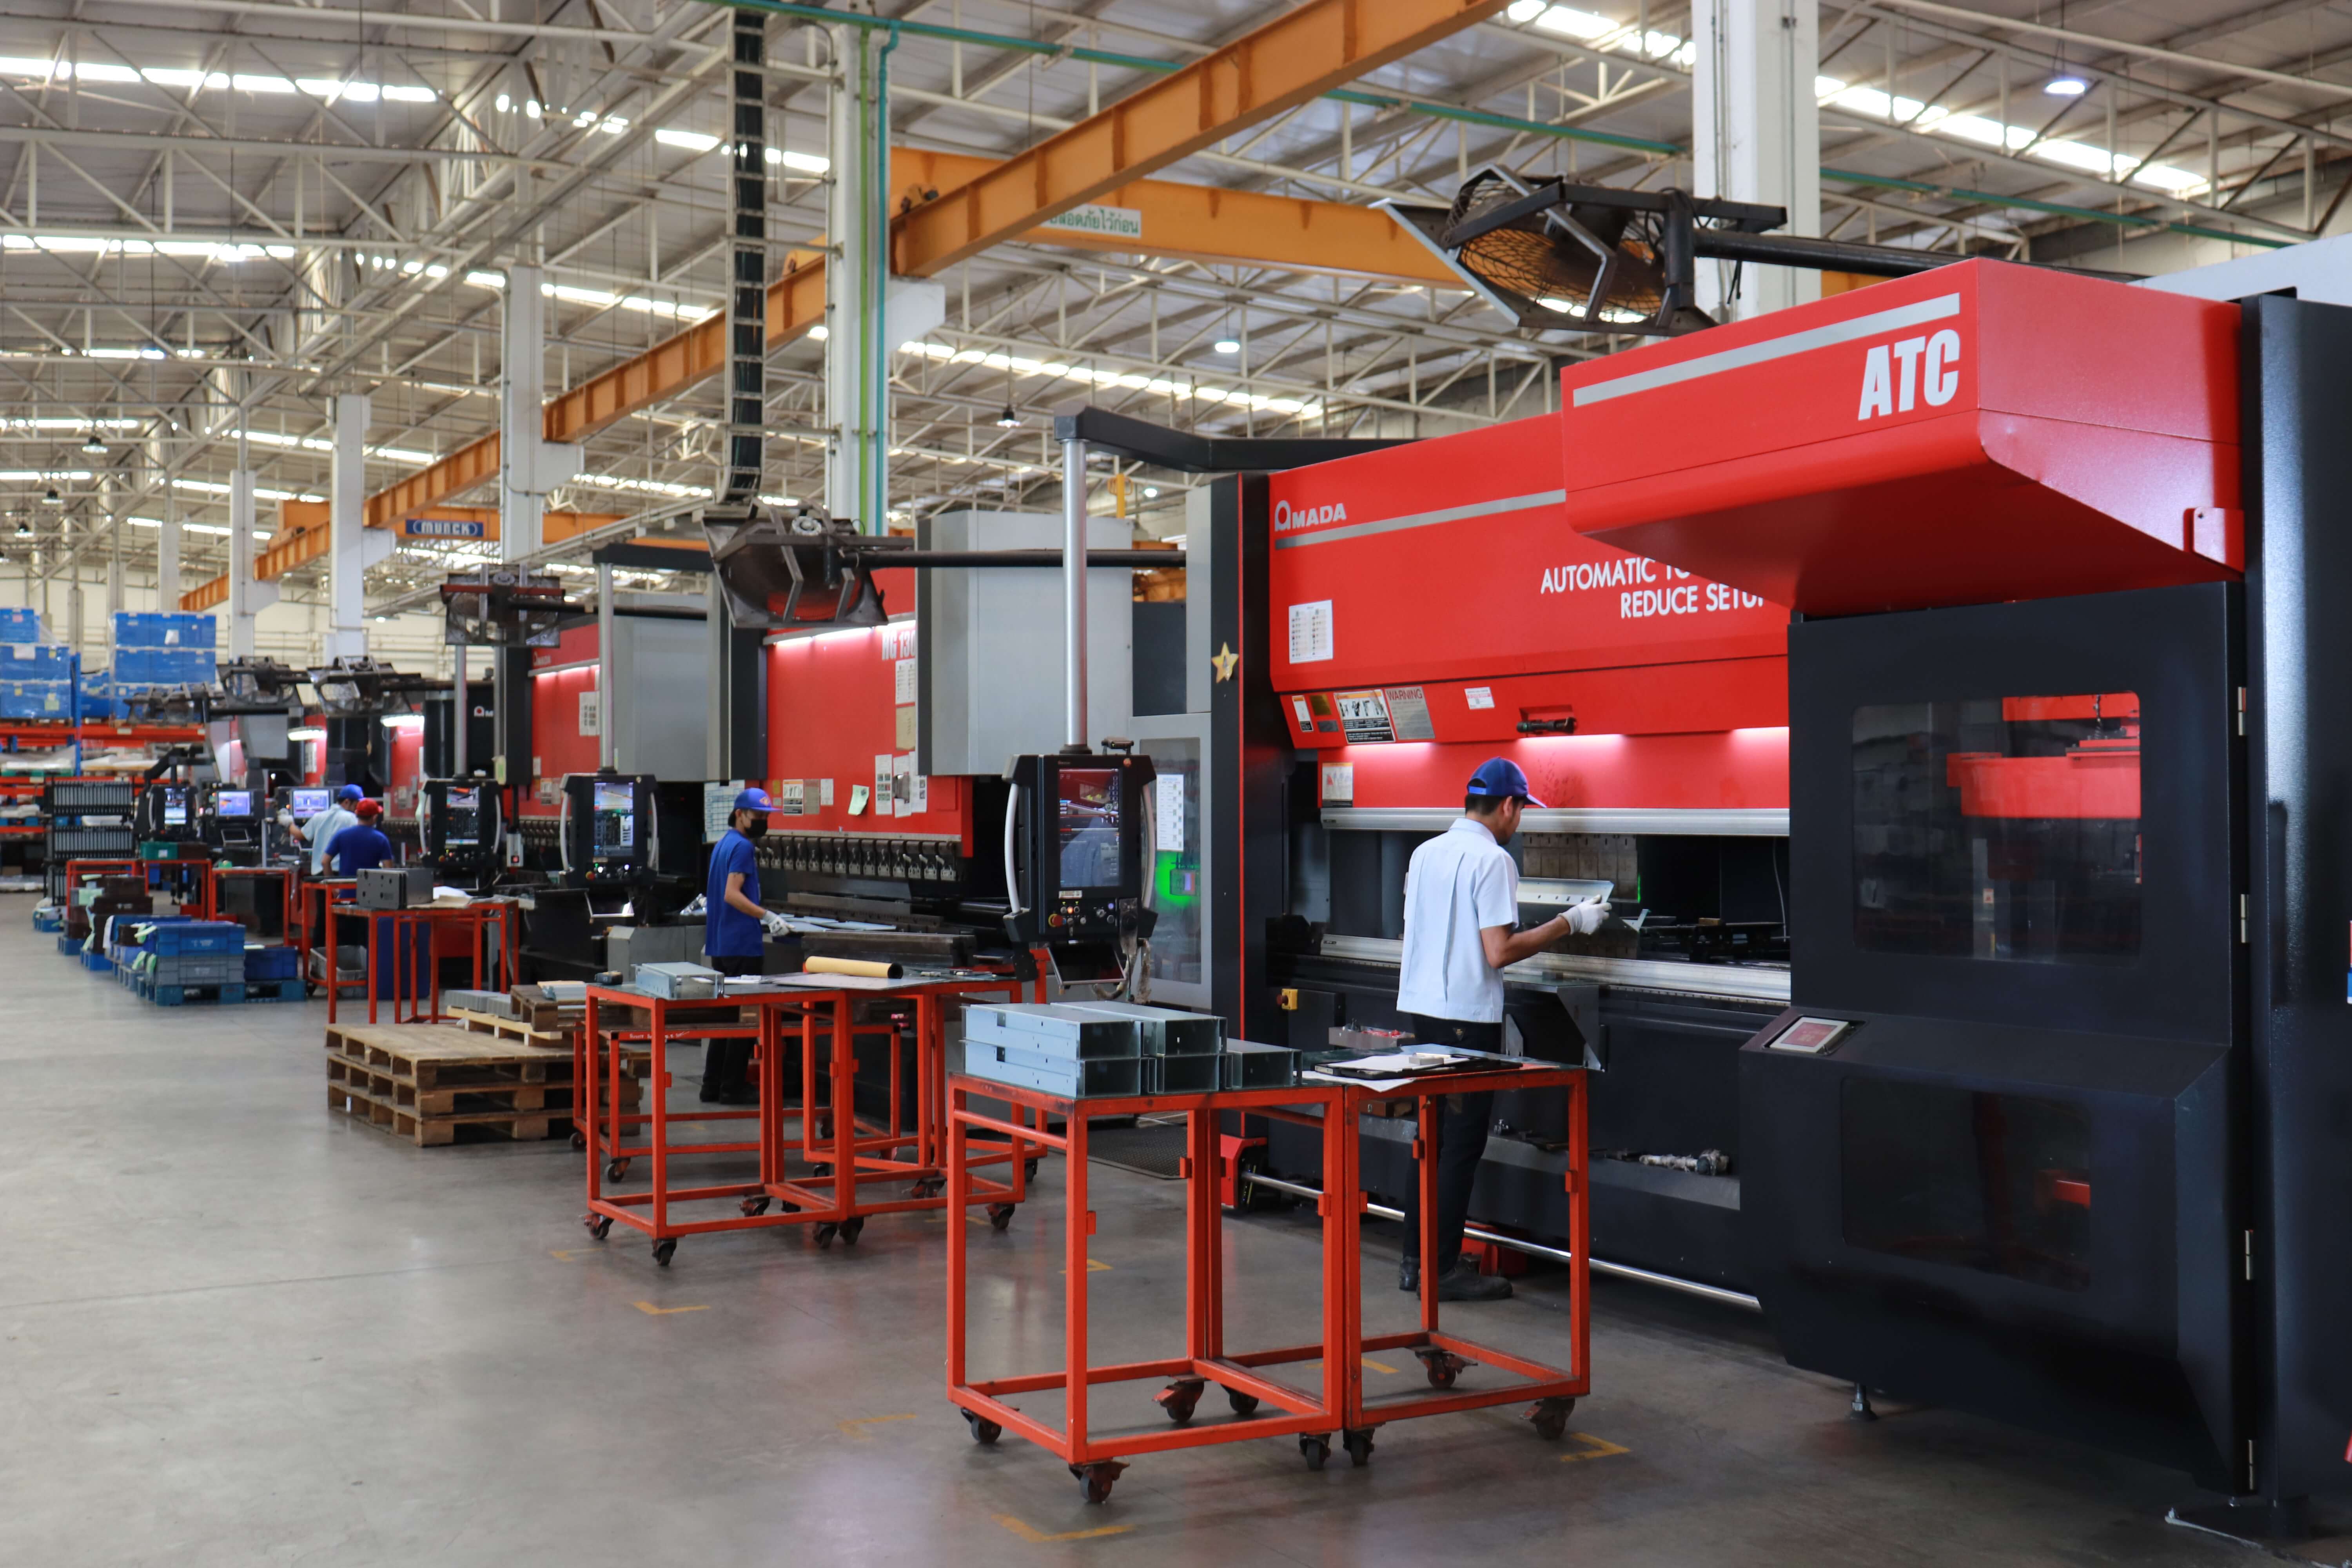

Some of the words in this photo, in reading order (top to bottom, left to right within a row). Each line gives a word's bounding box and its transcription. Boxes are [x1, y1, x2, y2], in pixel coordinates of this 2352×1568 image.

[1858, 329, 1960, 421] ATC
[421, 521, 470, 536] MUNCK
[1275, 500, 1347, 532] AMADA
[1541, 557, 1656, 594] AUTOMATIC
[1621, 586, 1698, 619] REDUCE
[1387, 689, 1423, 701] WARNING
